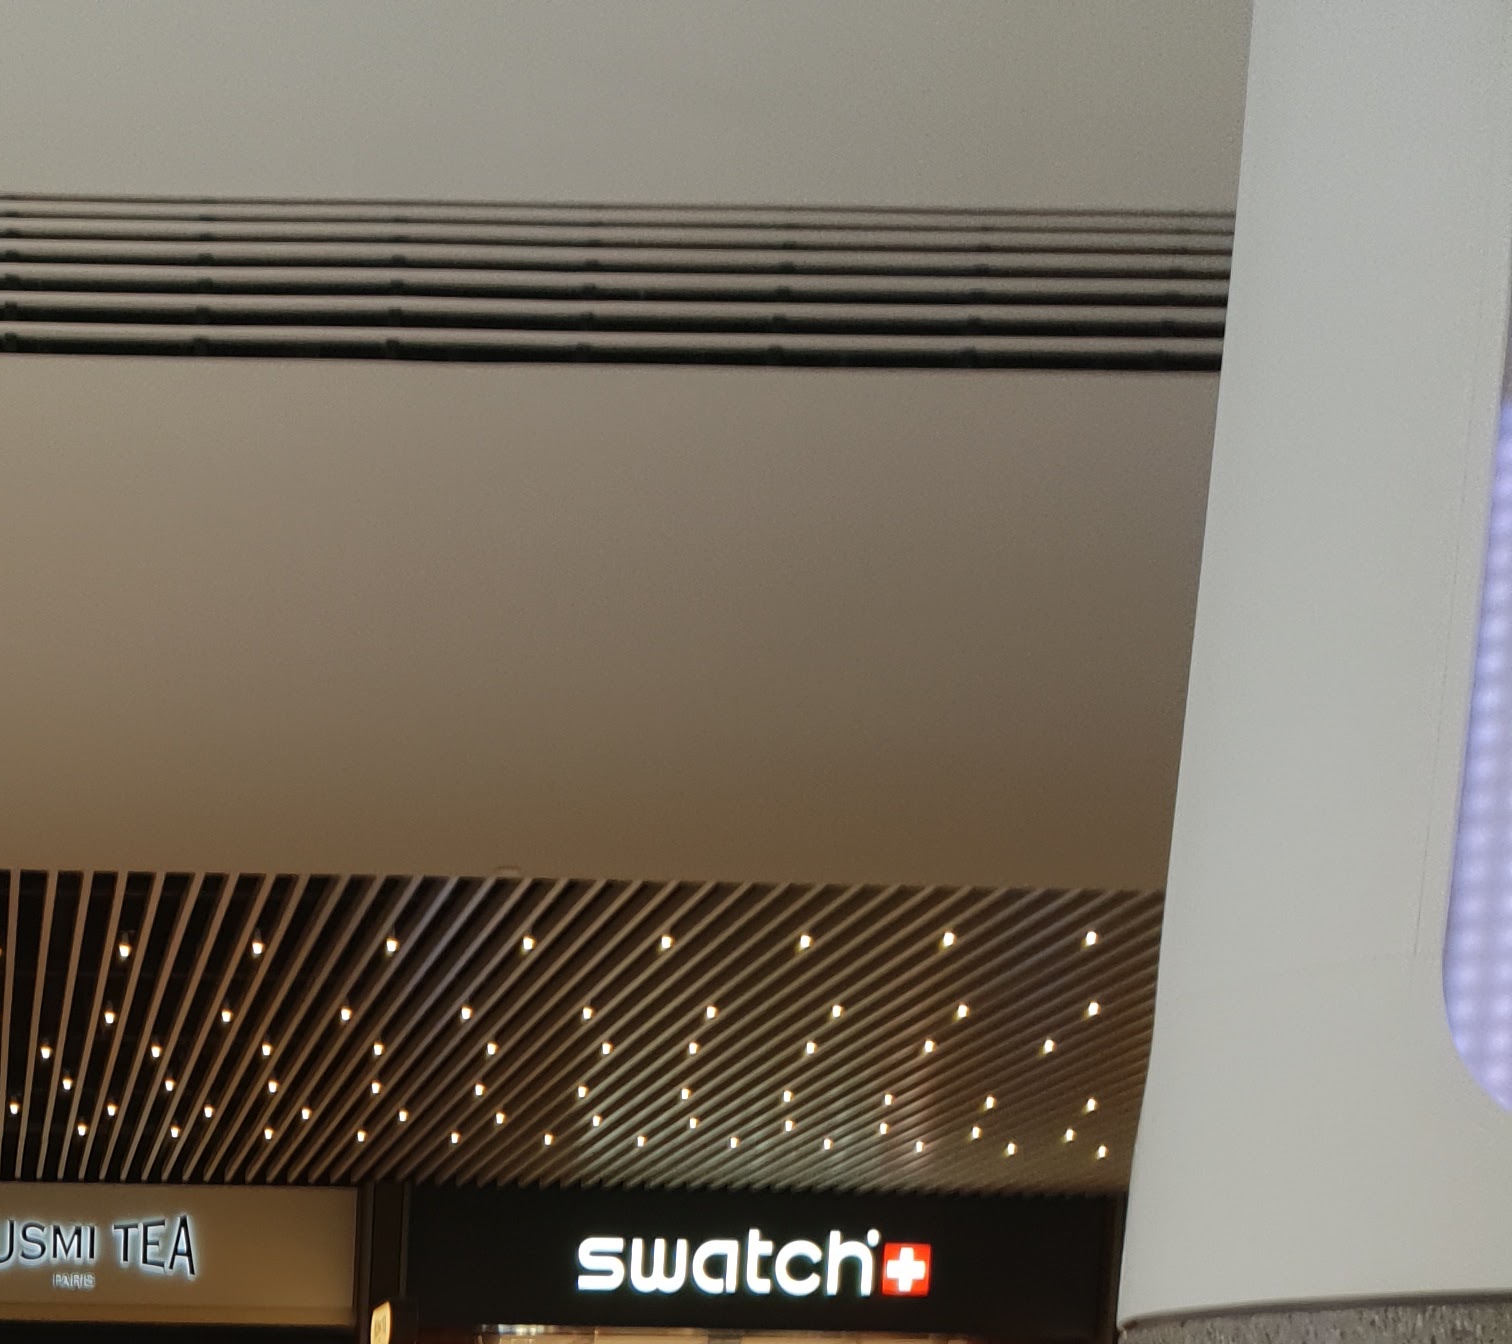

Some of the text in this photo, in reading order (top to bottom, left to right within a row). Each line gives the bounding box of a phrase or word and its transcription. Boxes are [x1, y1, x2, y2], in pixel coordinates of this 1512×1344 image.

[112, 1214, 196, 1277] TEA
[576, 1228, 876, 1296] swatch
[52, 1272, 96, 1289] PARIS
